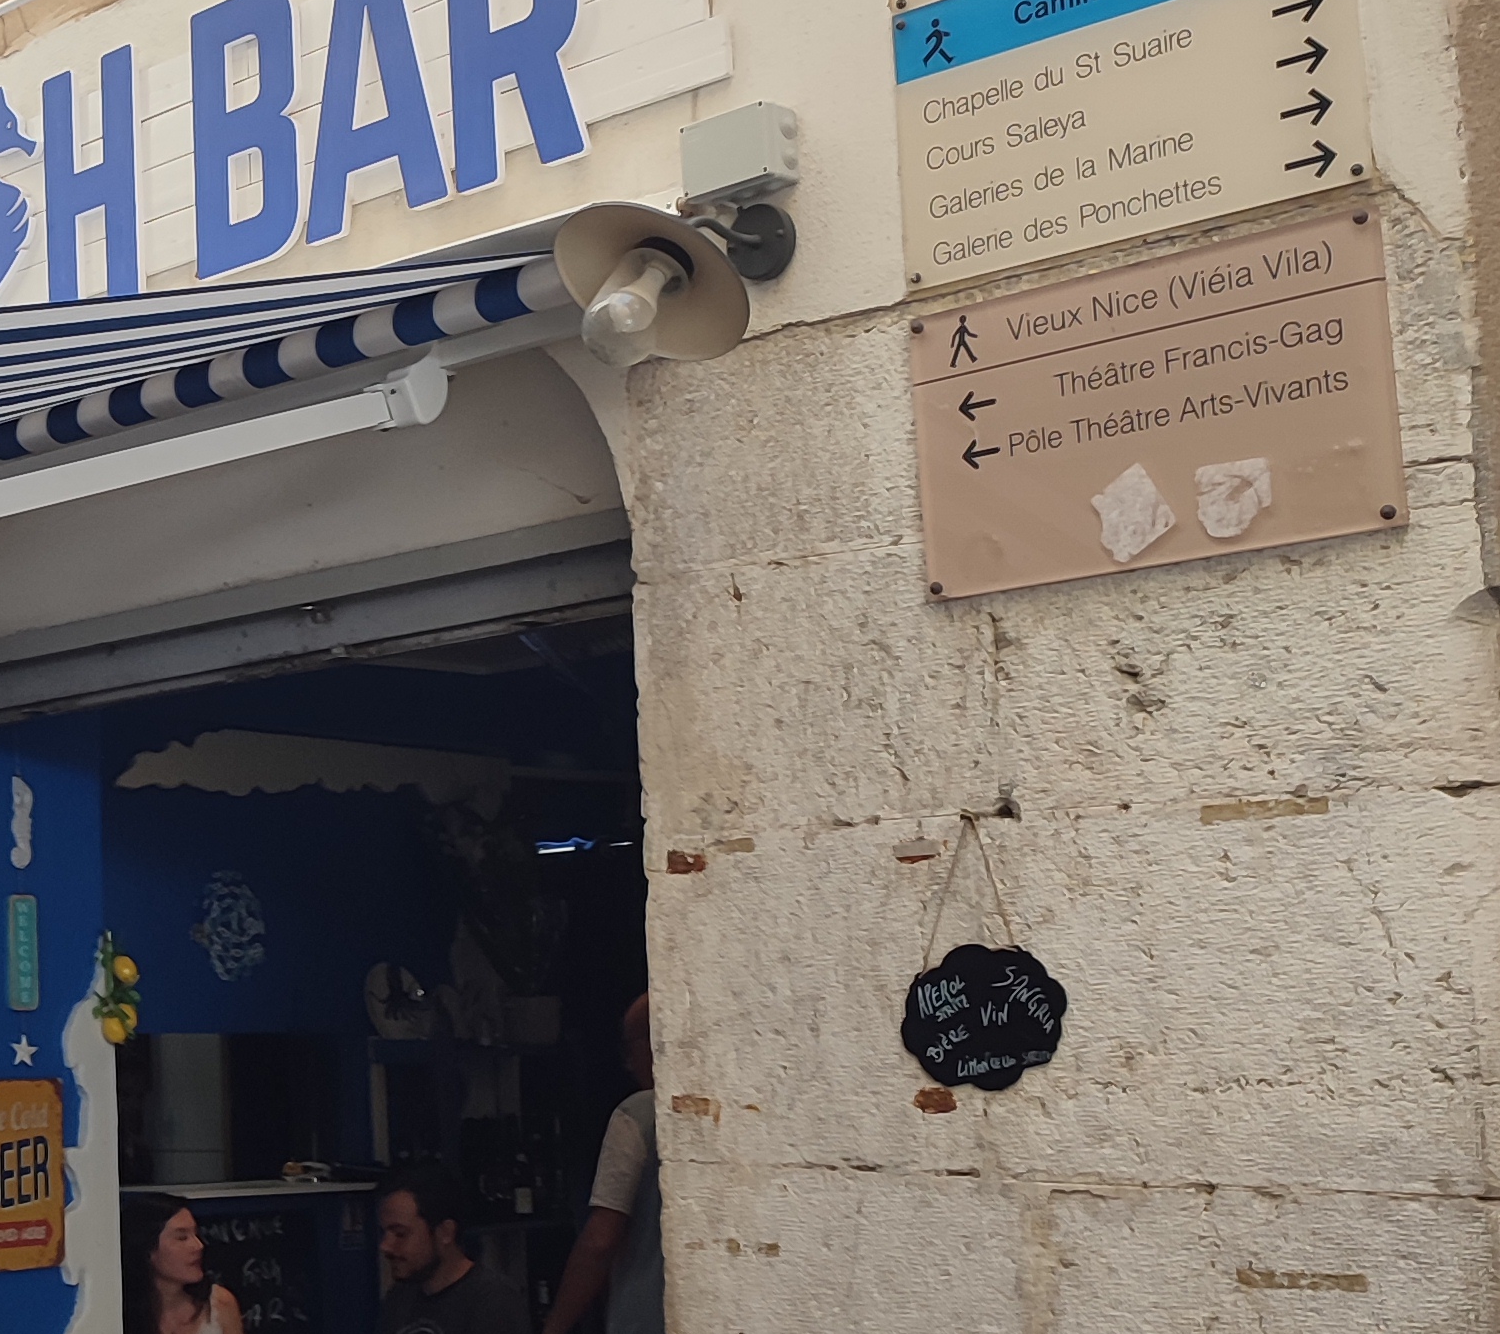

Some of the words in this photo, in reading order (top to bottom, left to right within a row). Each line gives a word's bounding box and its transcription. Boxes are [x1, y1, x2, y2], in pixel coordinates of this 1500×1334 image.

[923, 76, 1024, 125] Chapelle
[1034, 64, 1064, 93] du
[1075, 52, 1102, 79] St
[1113, 26, 1193, 69] Suaire
[925, 136, 995, 171] Cours
[1006, 106, 1086, 149] Saleya
[928, 176, 1024, 220] Galeries
[1033, 166, 1065, 192] de
[1076, 156, 1096, 179] la
[1108, 130, 1194, 171] Marine
[932, 227, 1014, 266] Galerie
[1023, 211, 1068, 240] des
[1079, 174, 1222, 229] Ponchettes
[1007, 297, 1083, 342] Vieux
[1092, 284, 1158, 320] Nice
[1168, 264, 1255, 312] (Viéia
[1263, 240, 1334, 282] Vila)
[1054, 353, 1155, 398] Théâtre
[1164, 316, 1345, 379] Francis-Gag
[1009, 427, 1062, 457] Pôle
[1069, 401, 1170, 442] Théâtre
[1179, 370, 1349, 423] Arts-Vivants
[15, 901, 31, 1003] WELCOME
[918, 975, 966, 1018] APEROL
[991, 966, 1054, 1034] SANGRIA
[11, 1101, 49, 1131] Cold
